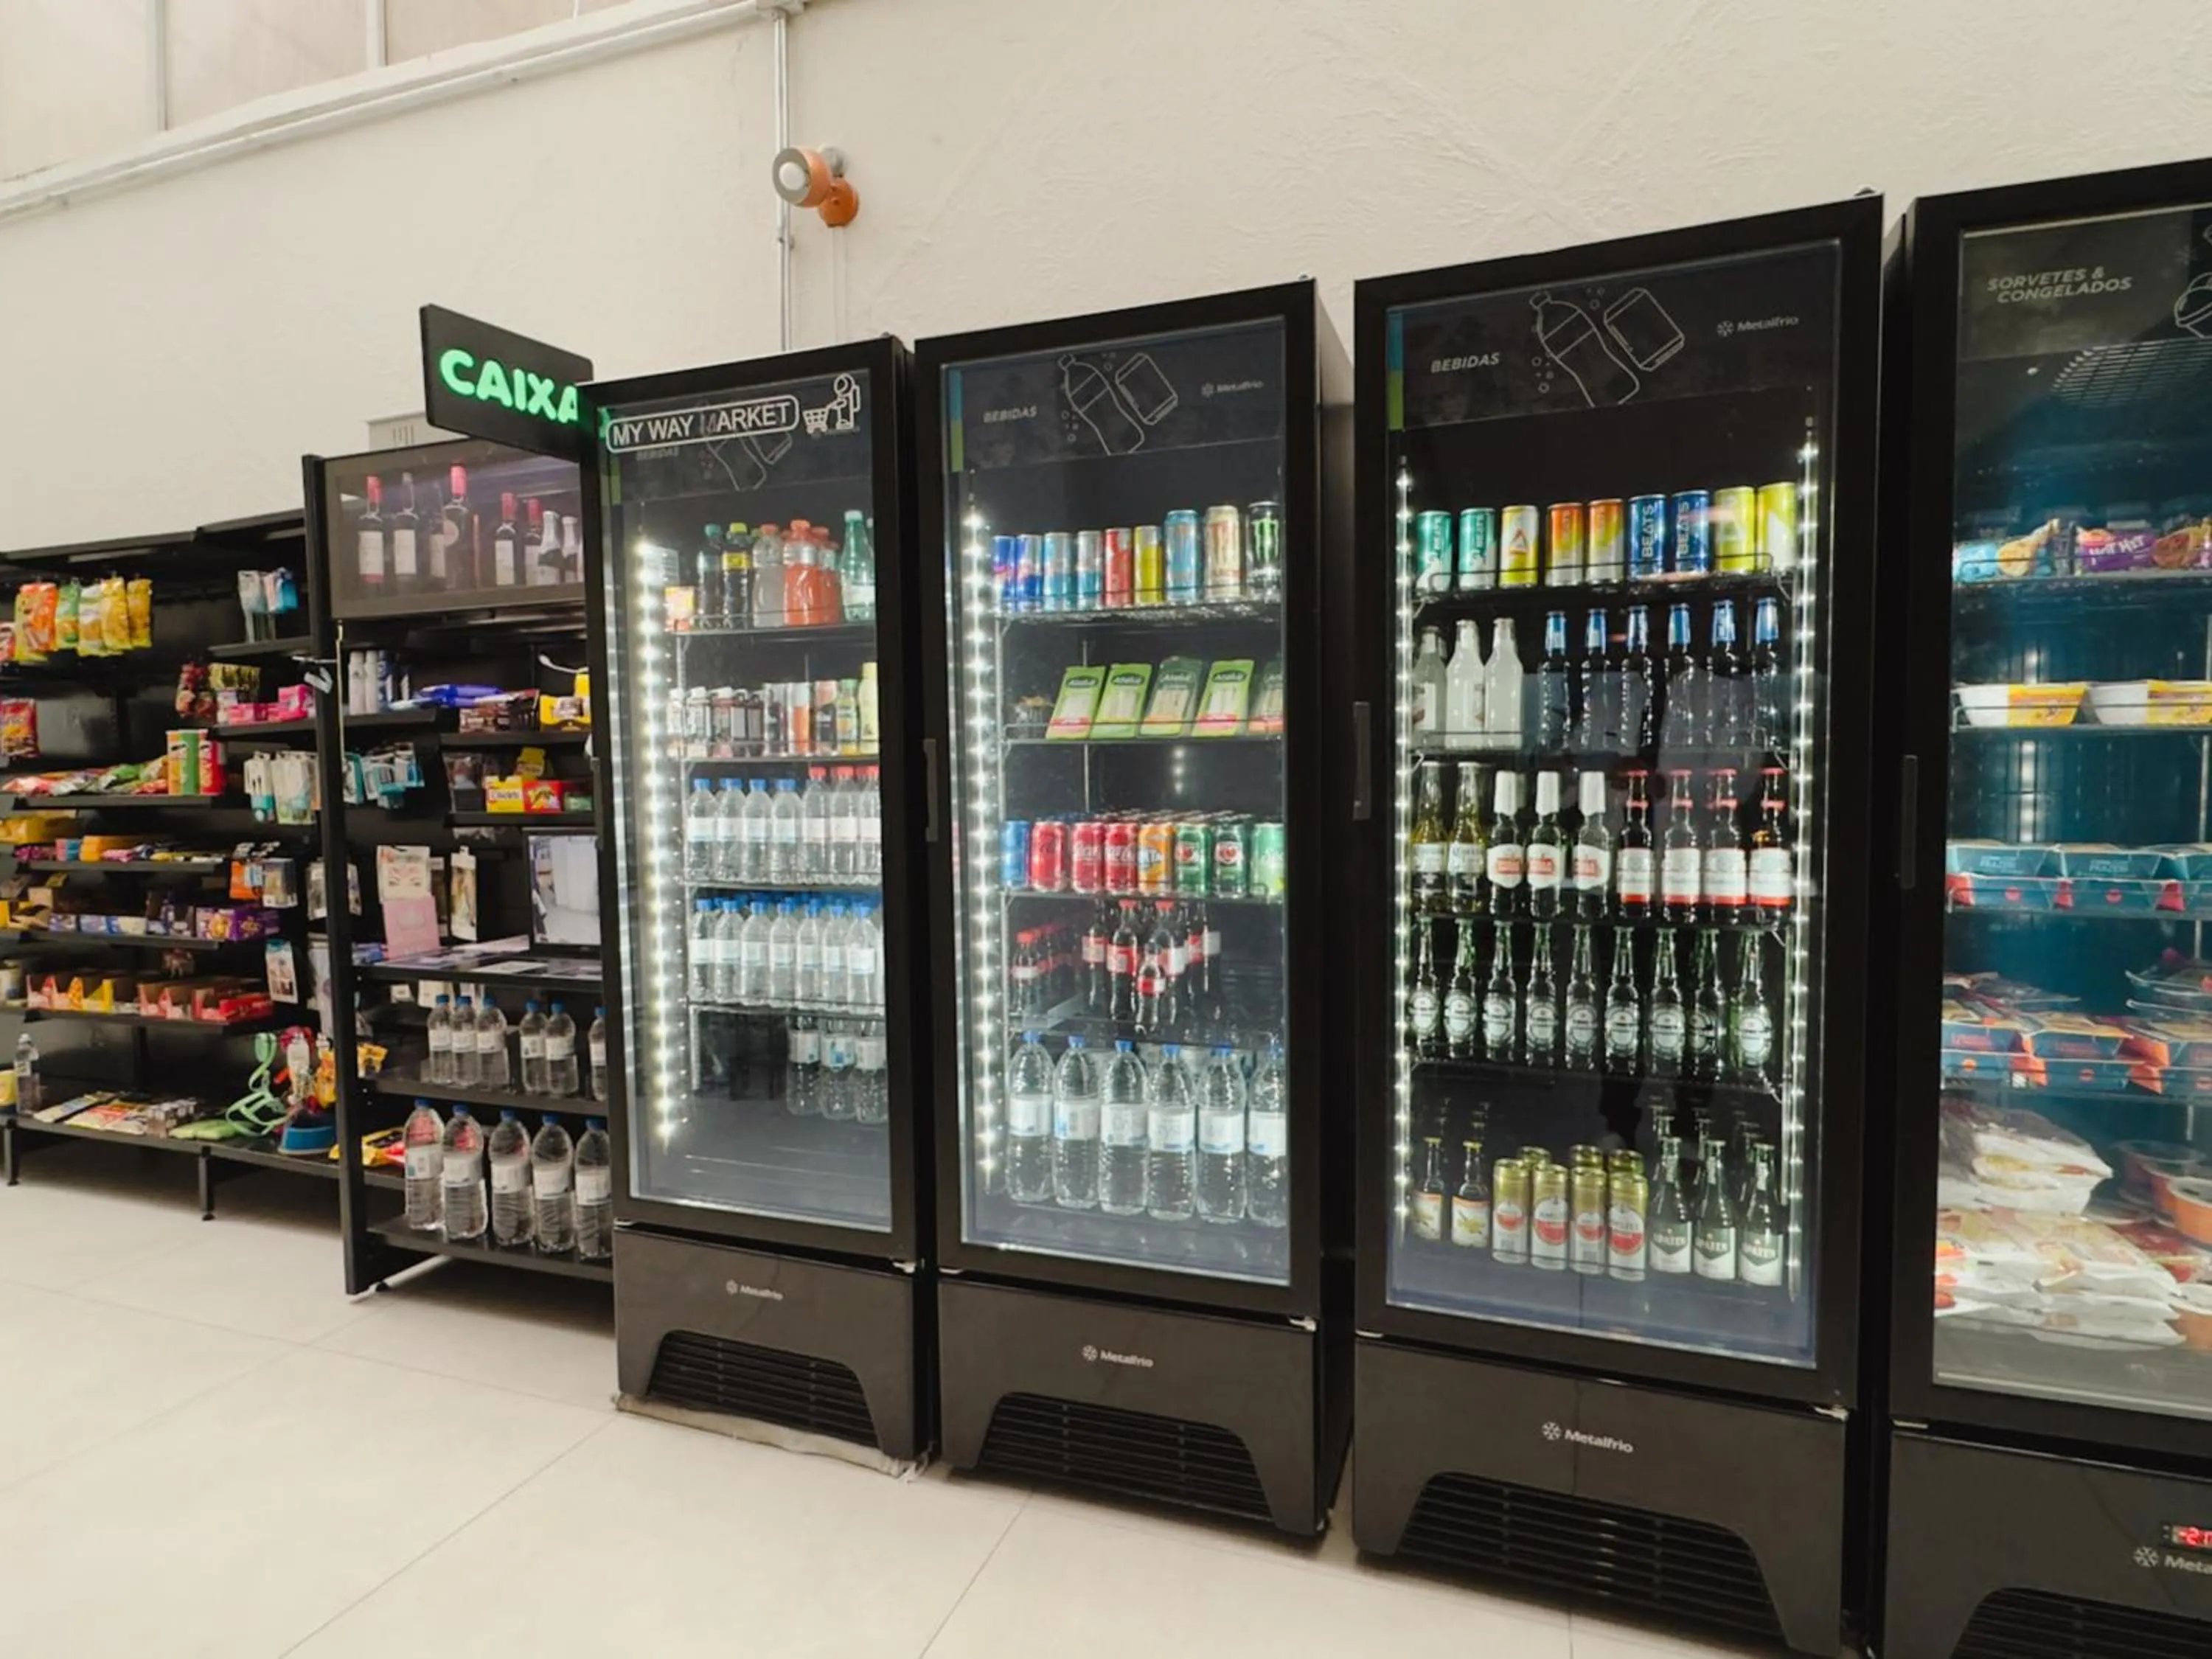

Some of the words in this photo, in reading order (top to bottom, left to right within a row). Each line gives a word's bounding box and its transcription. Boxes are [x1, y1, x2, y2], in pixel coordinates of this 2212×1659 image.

[1986, 268, 2087, 291] SORVETES
[2091, 265, 2105, 280] &
[1996, 276, 2133, 304] CONGELADOS
[1430, 352, 1501, 374] BEBIDAS
[439, 348, 579, 423] CAIXA
[982, 404, 1038, 424] BEBIDAS
[613, 422, 644, 447] MY
[647, 414, 694, 442] WAY
[1641, 504, 1655, 558] BEATS
[1564, 1428, 1634, 1454] Metalfrio
